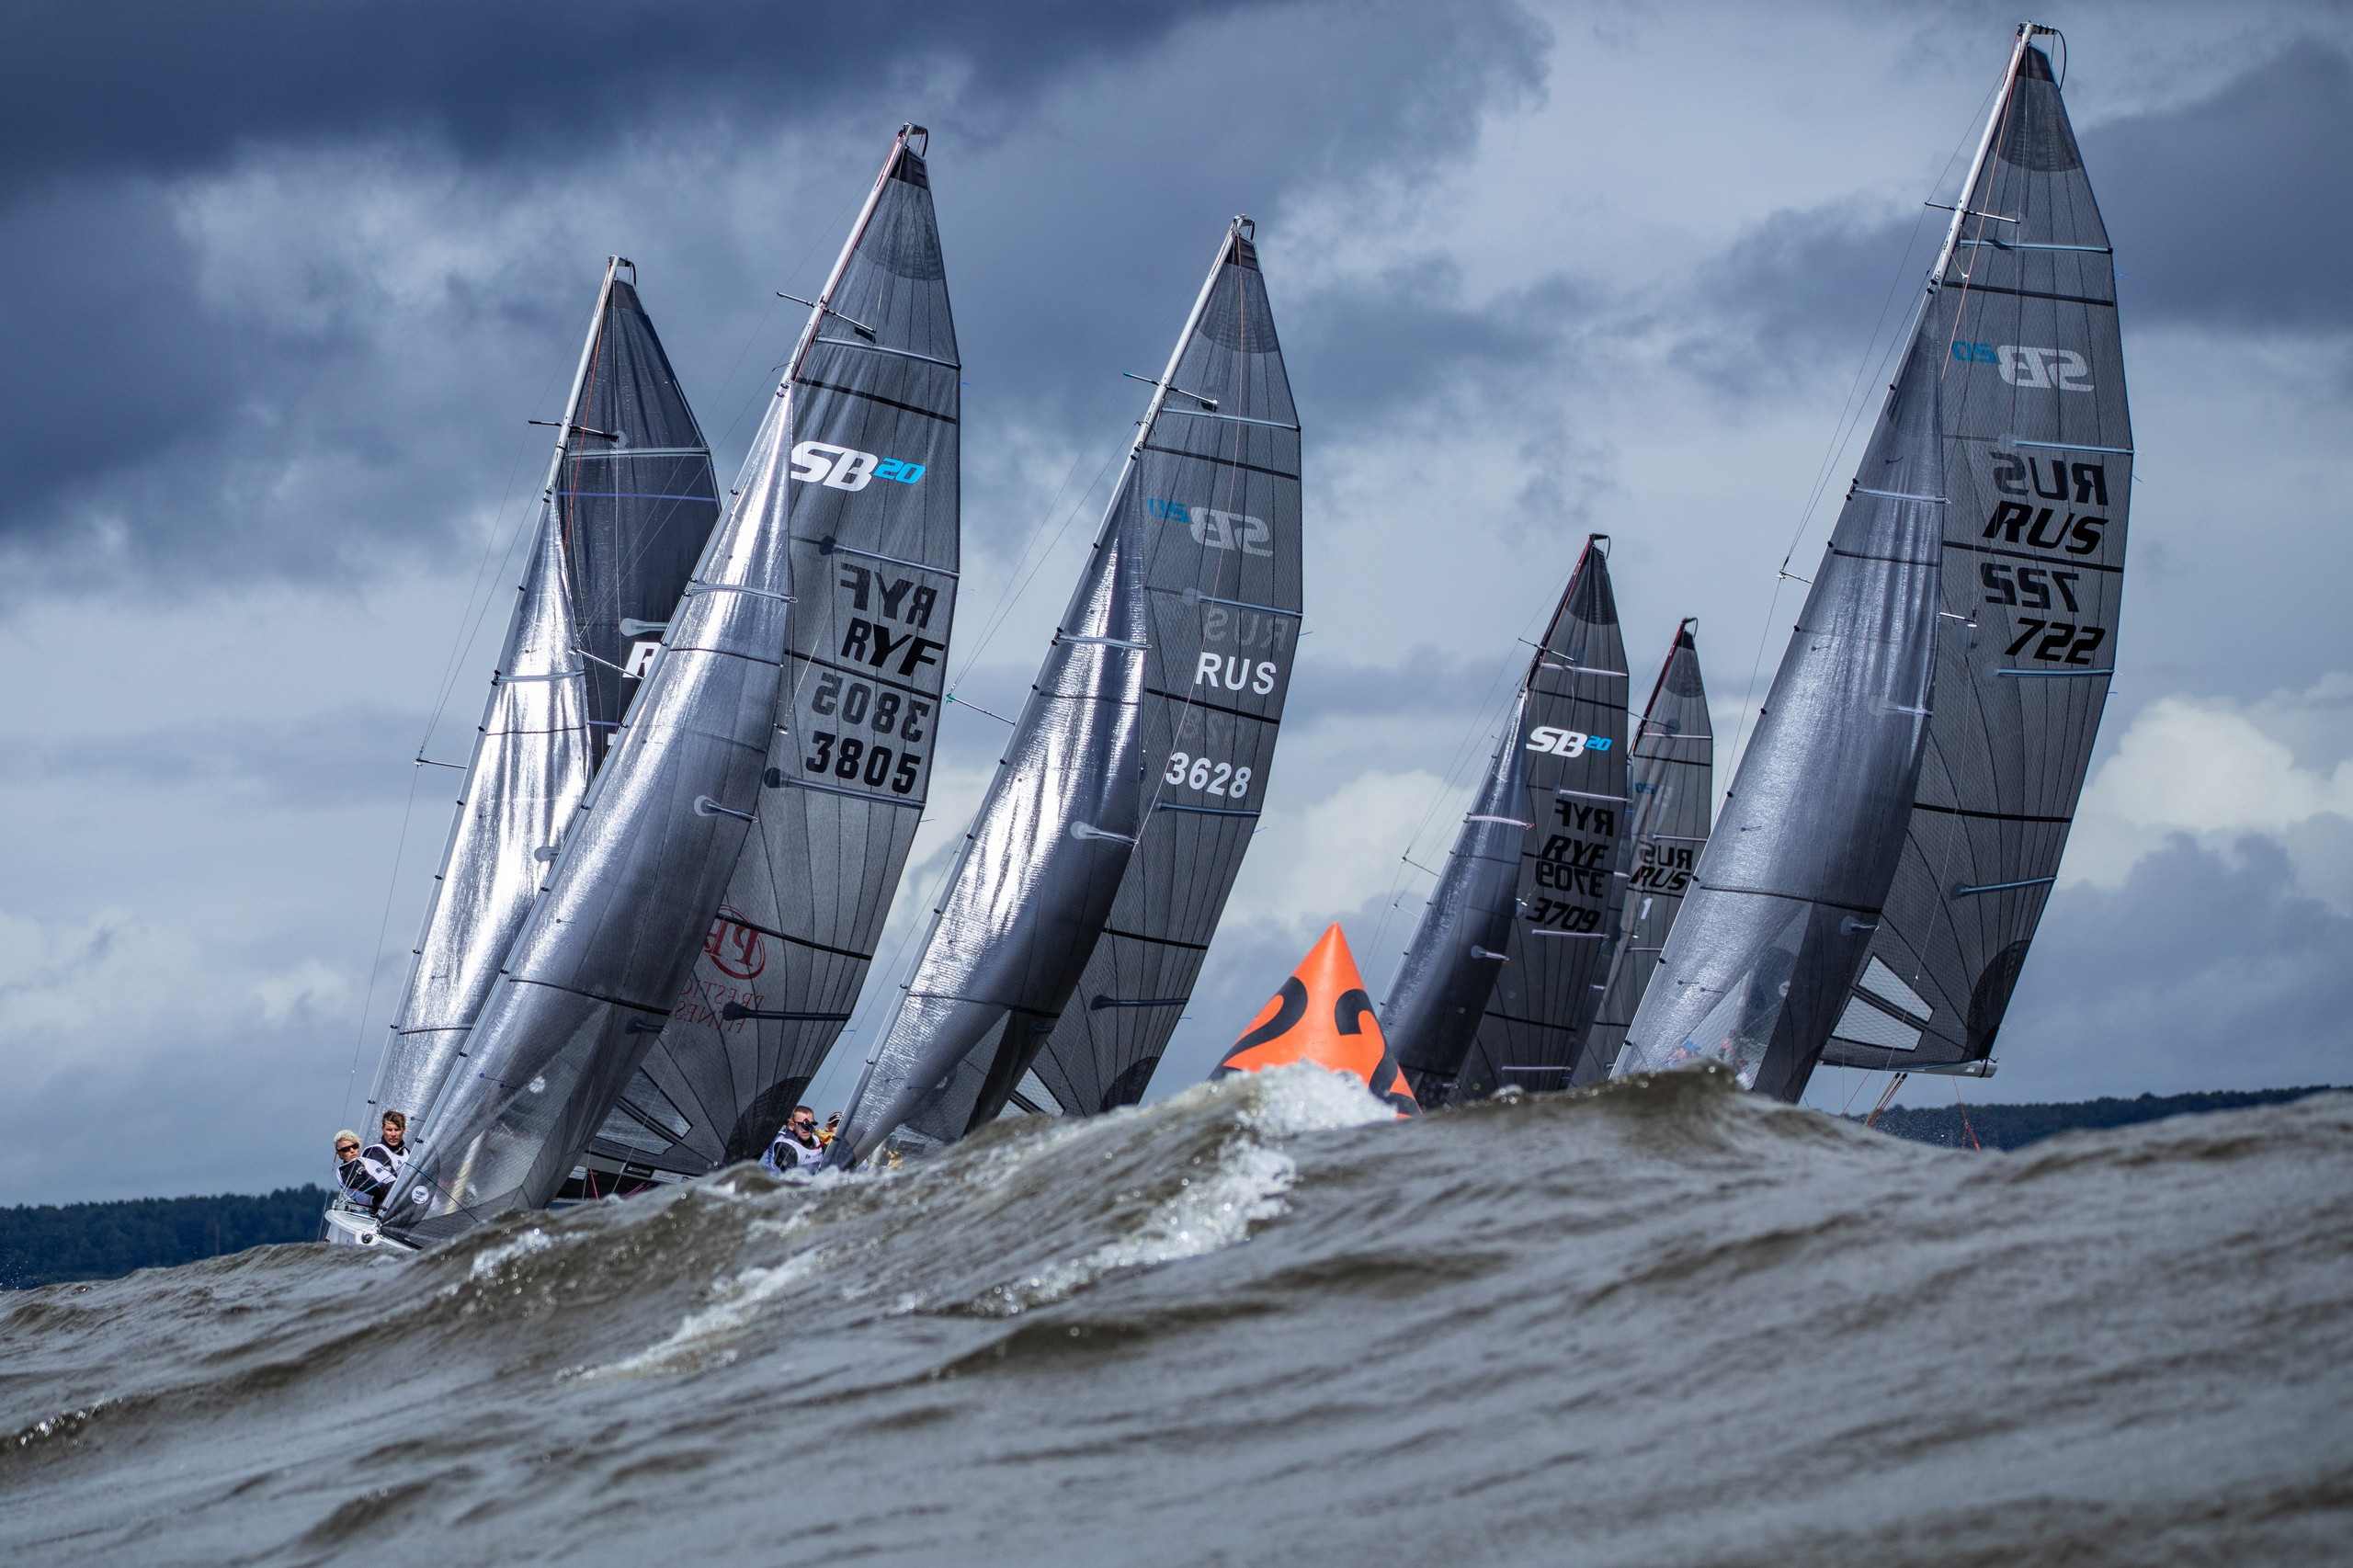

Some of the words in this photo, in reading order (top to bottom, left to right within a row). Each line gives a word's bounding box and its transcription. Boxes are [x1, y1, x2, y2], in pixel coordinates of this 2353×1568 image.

[790, 440, 926, 492] SB20
[1982, 501, 2109, 554] RUS
[841, 617, 946, 676] RYF
[2004, 617, 2106, 665] 722
[1195, 652, 1277, 695] RUS
[805, 731, 921, 794] 3805
[1526, 726, 1612, 758] SB20
[1165, 752, 1251, 798] 3628
[1540, 834, 1608, 869] RYF
[1629, 865, 1694, 891] RUS
[1526, 897, 1601, 933] 3709
